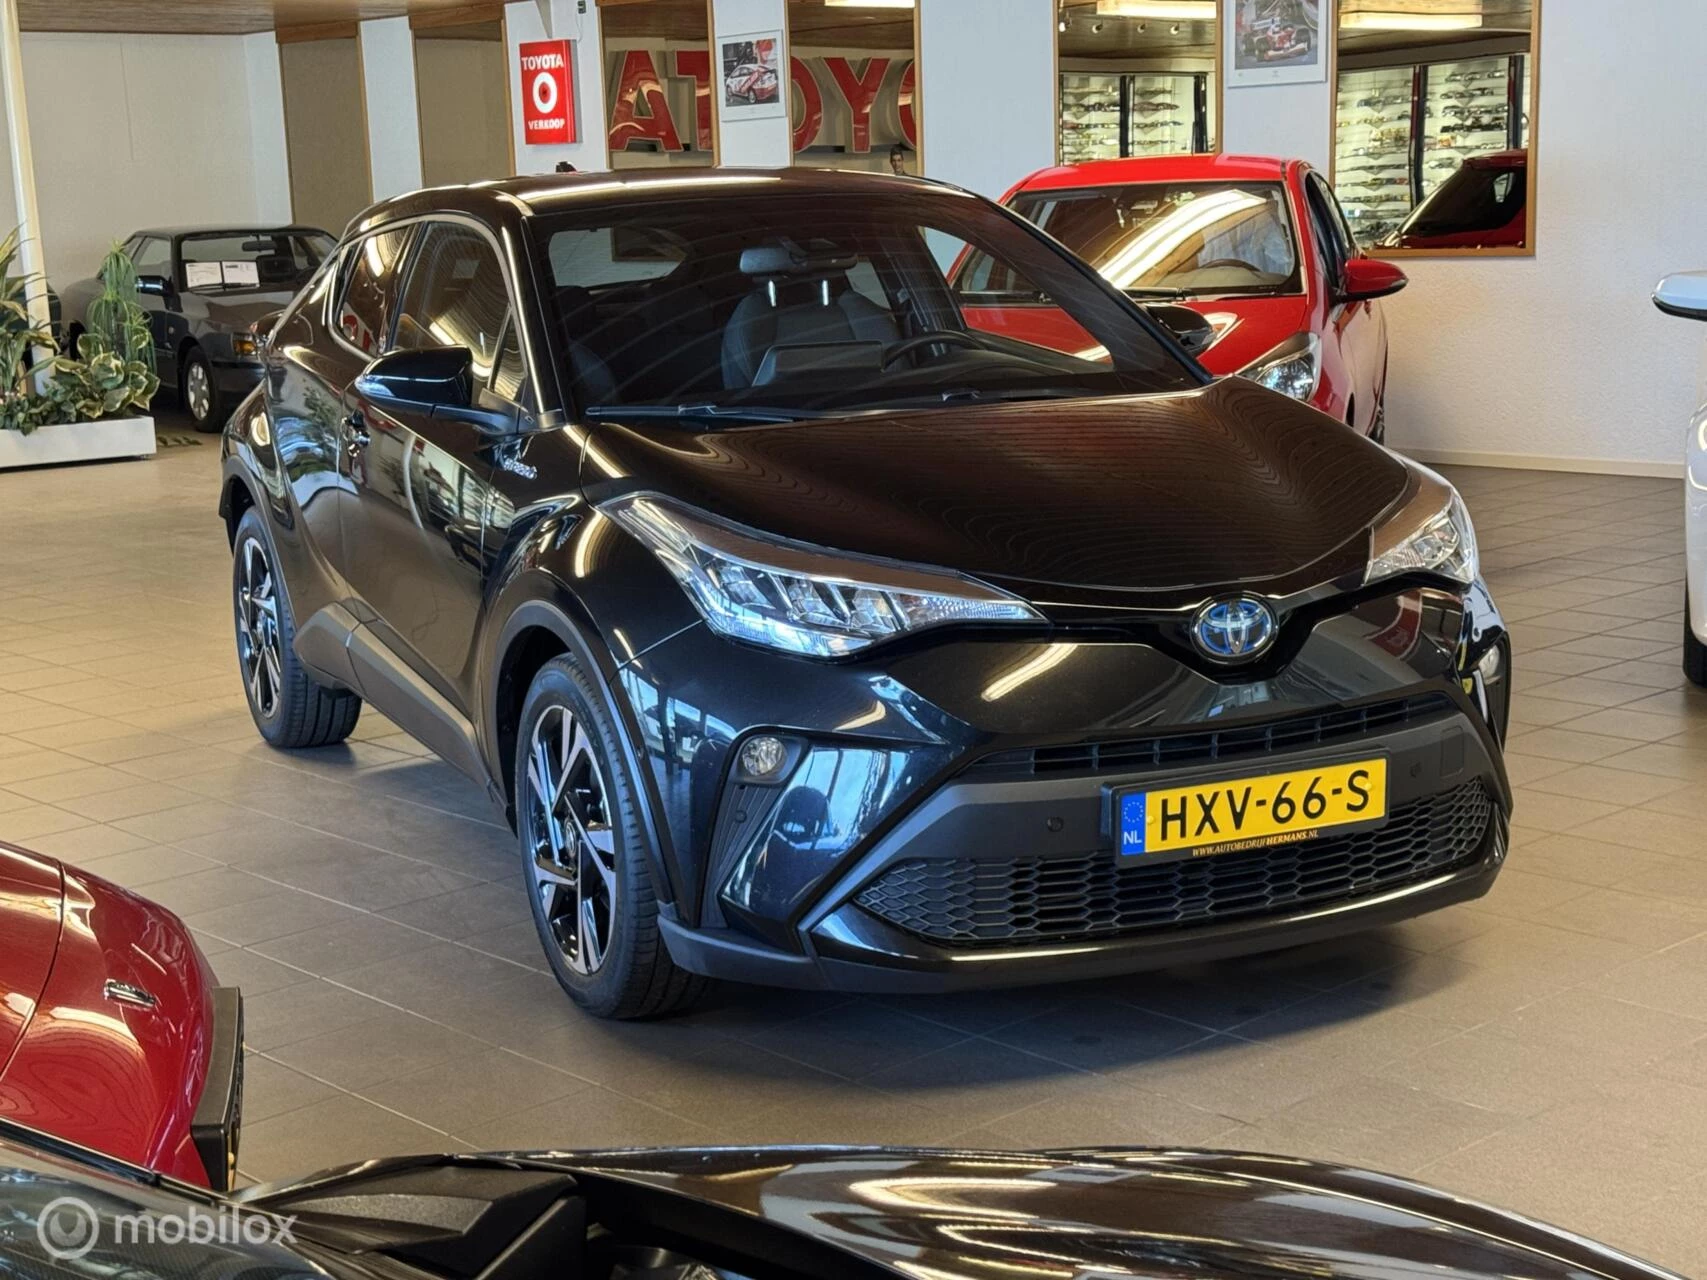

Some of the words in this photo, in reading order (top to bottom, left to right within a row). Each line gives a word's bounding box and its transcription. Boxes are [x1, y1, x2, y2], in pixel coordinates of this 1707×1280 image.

[521, 53, 564, 70] TOYOTA
[528, 118, 566, 130] VERKOOP
[1123, 830, 1142, 845] NL
[1160, 769, 1370, 842] HXV-66-S
